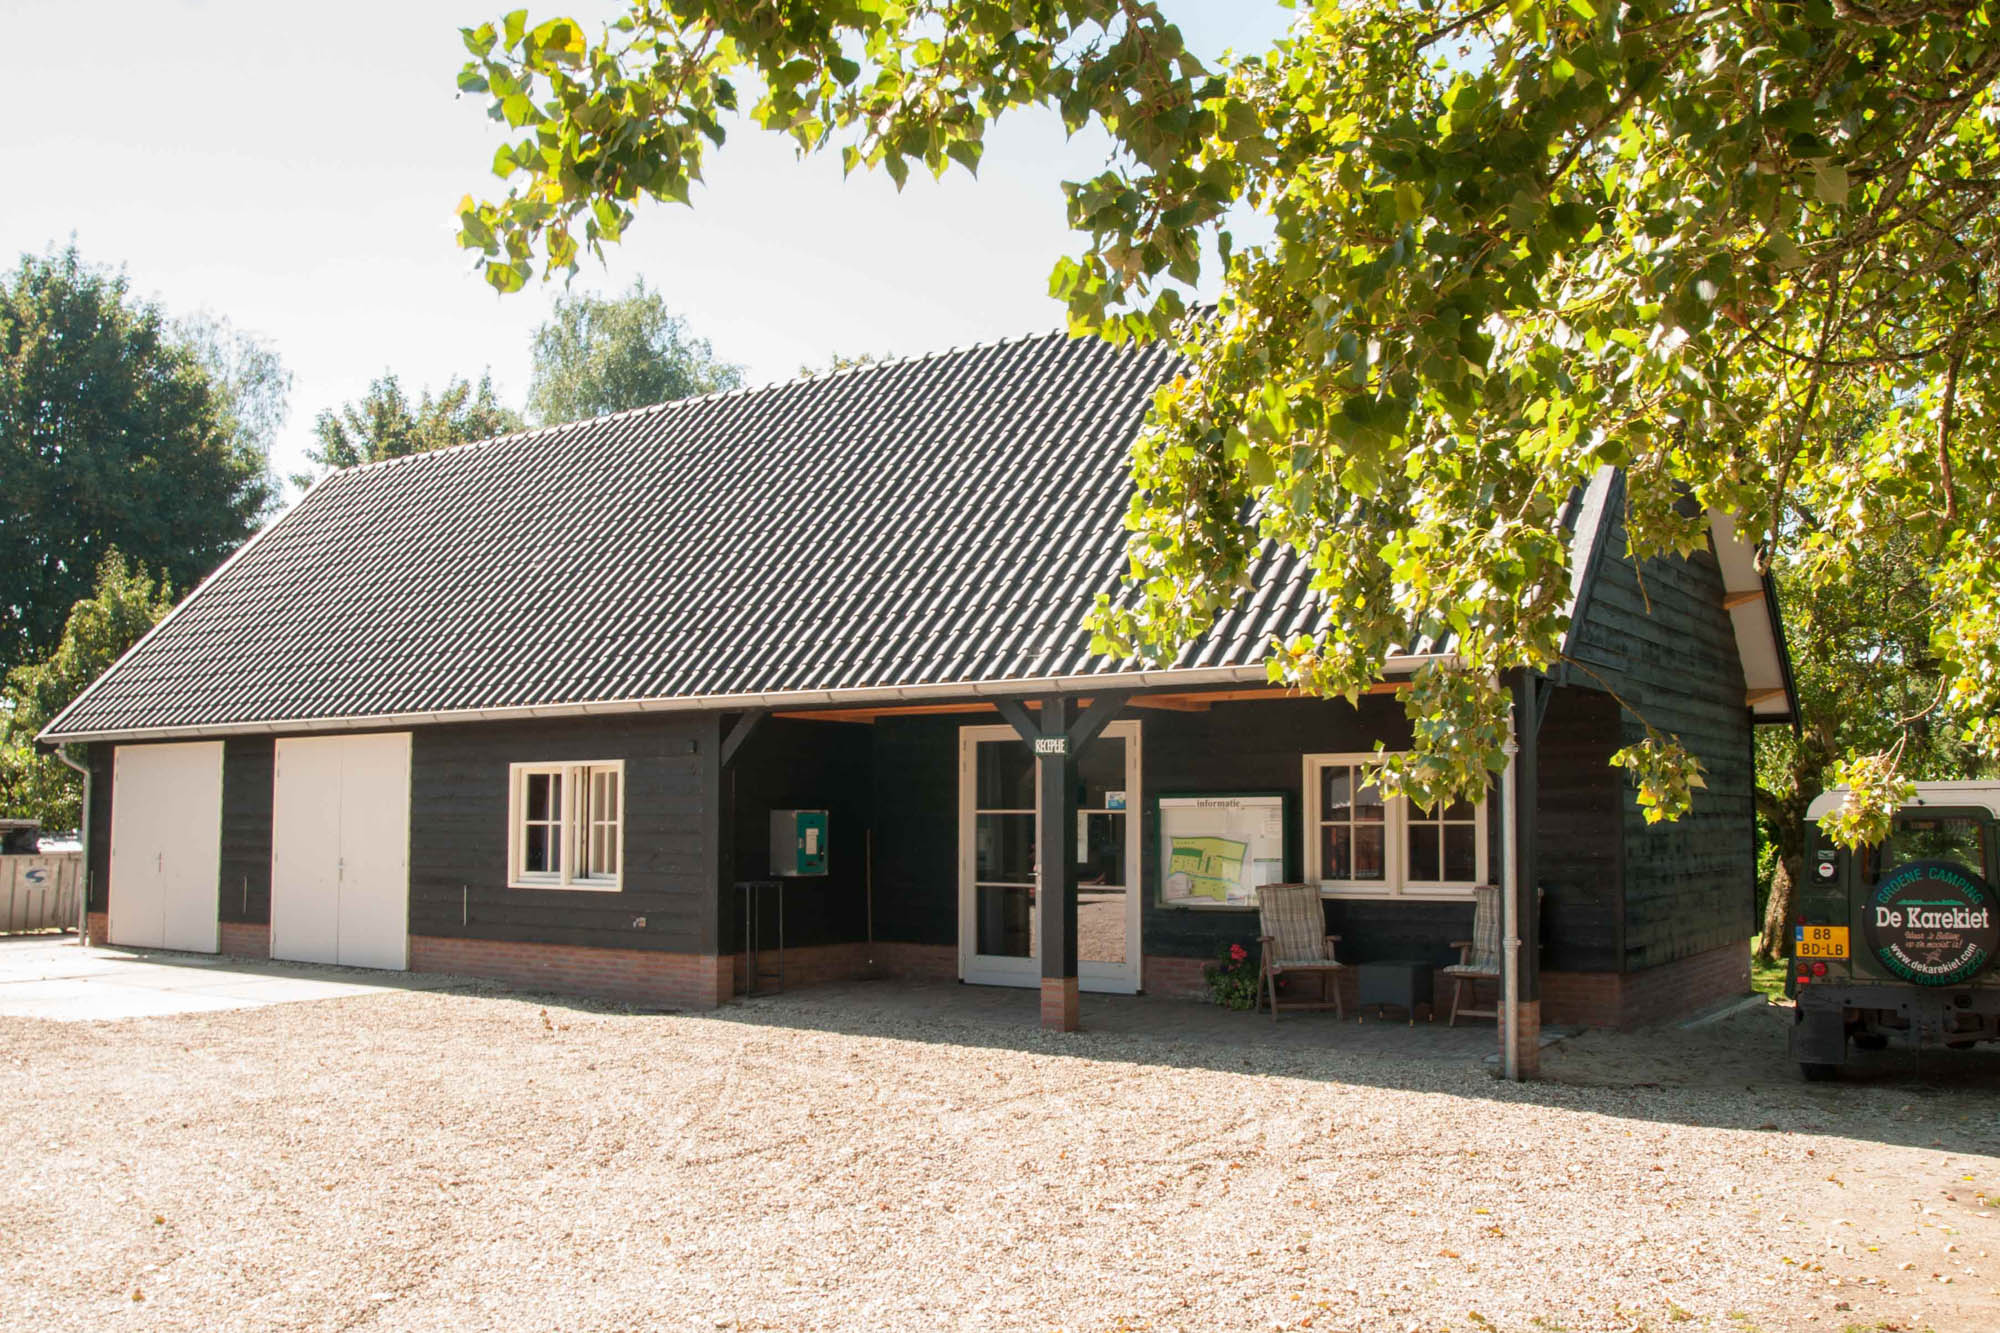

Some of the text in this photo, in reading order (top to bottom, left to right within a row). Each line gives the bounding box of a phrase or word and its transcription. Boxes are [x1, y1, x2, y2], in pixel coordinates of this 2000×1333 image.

[1877, 867, 1984, 904] GROENE CAMPING
[1875, 906, 1990, 929] De Karekiet
[1813, 928, 1831, 940] 88
[1890, 942, 1977, 974] www.dekarekiet.com
